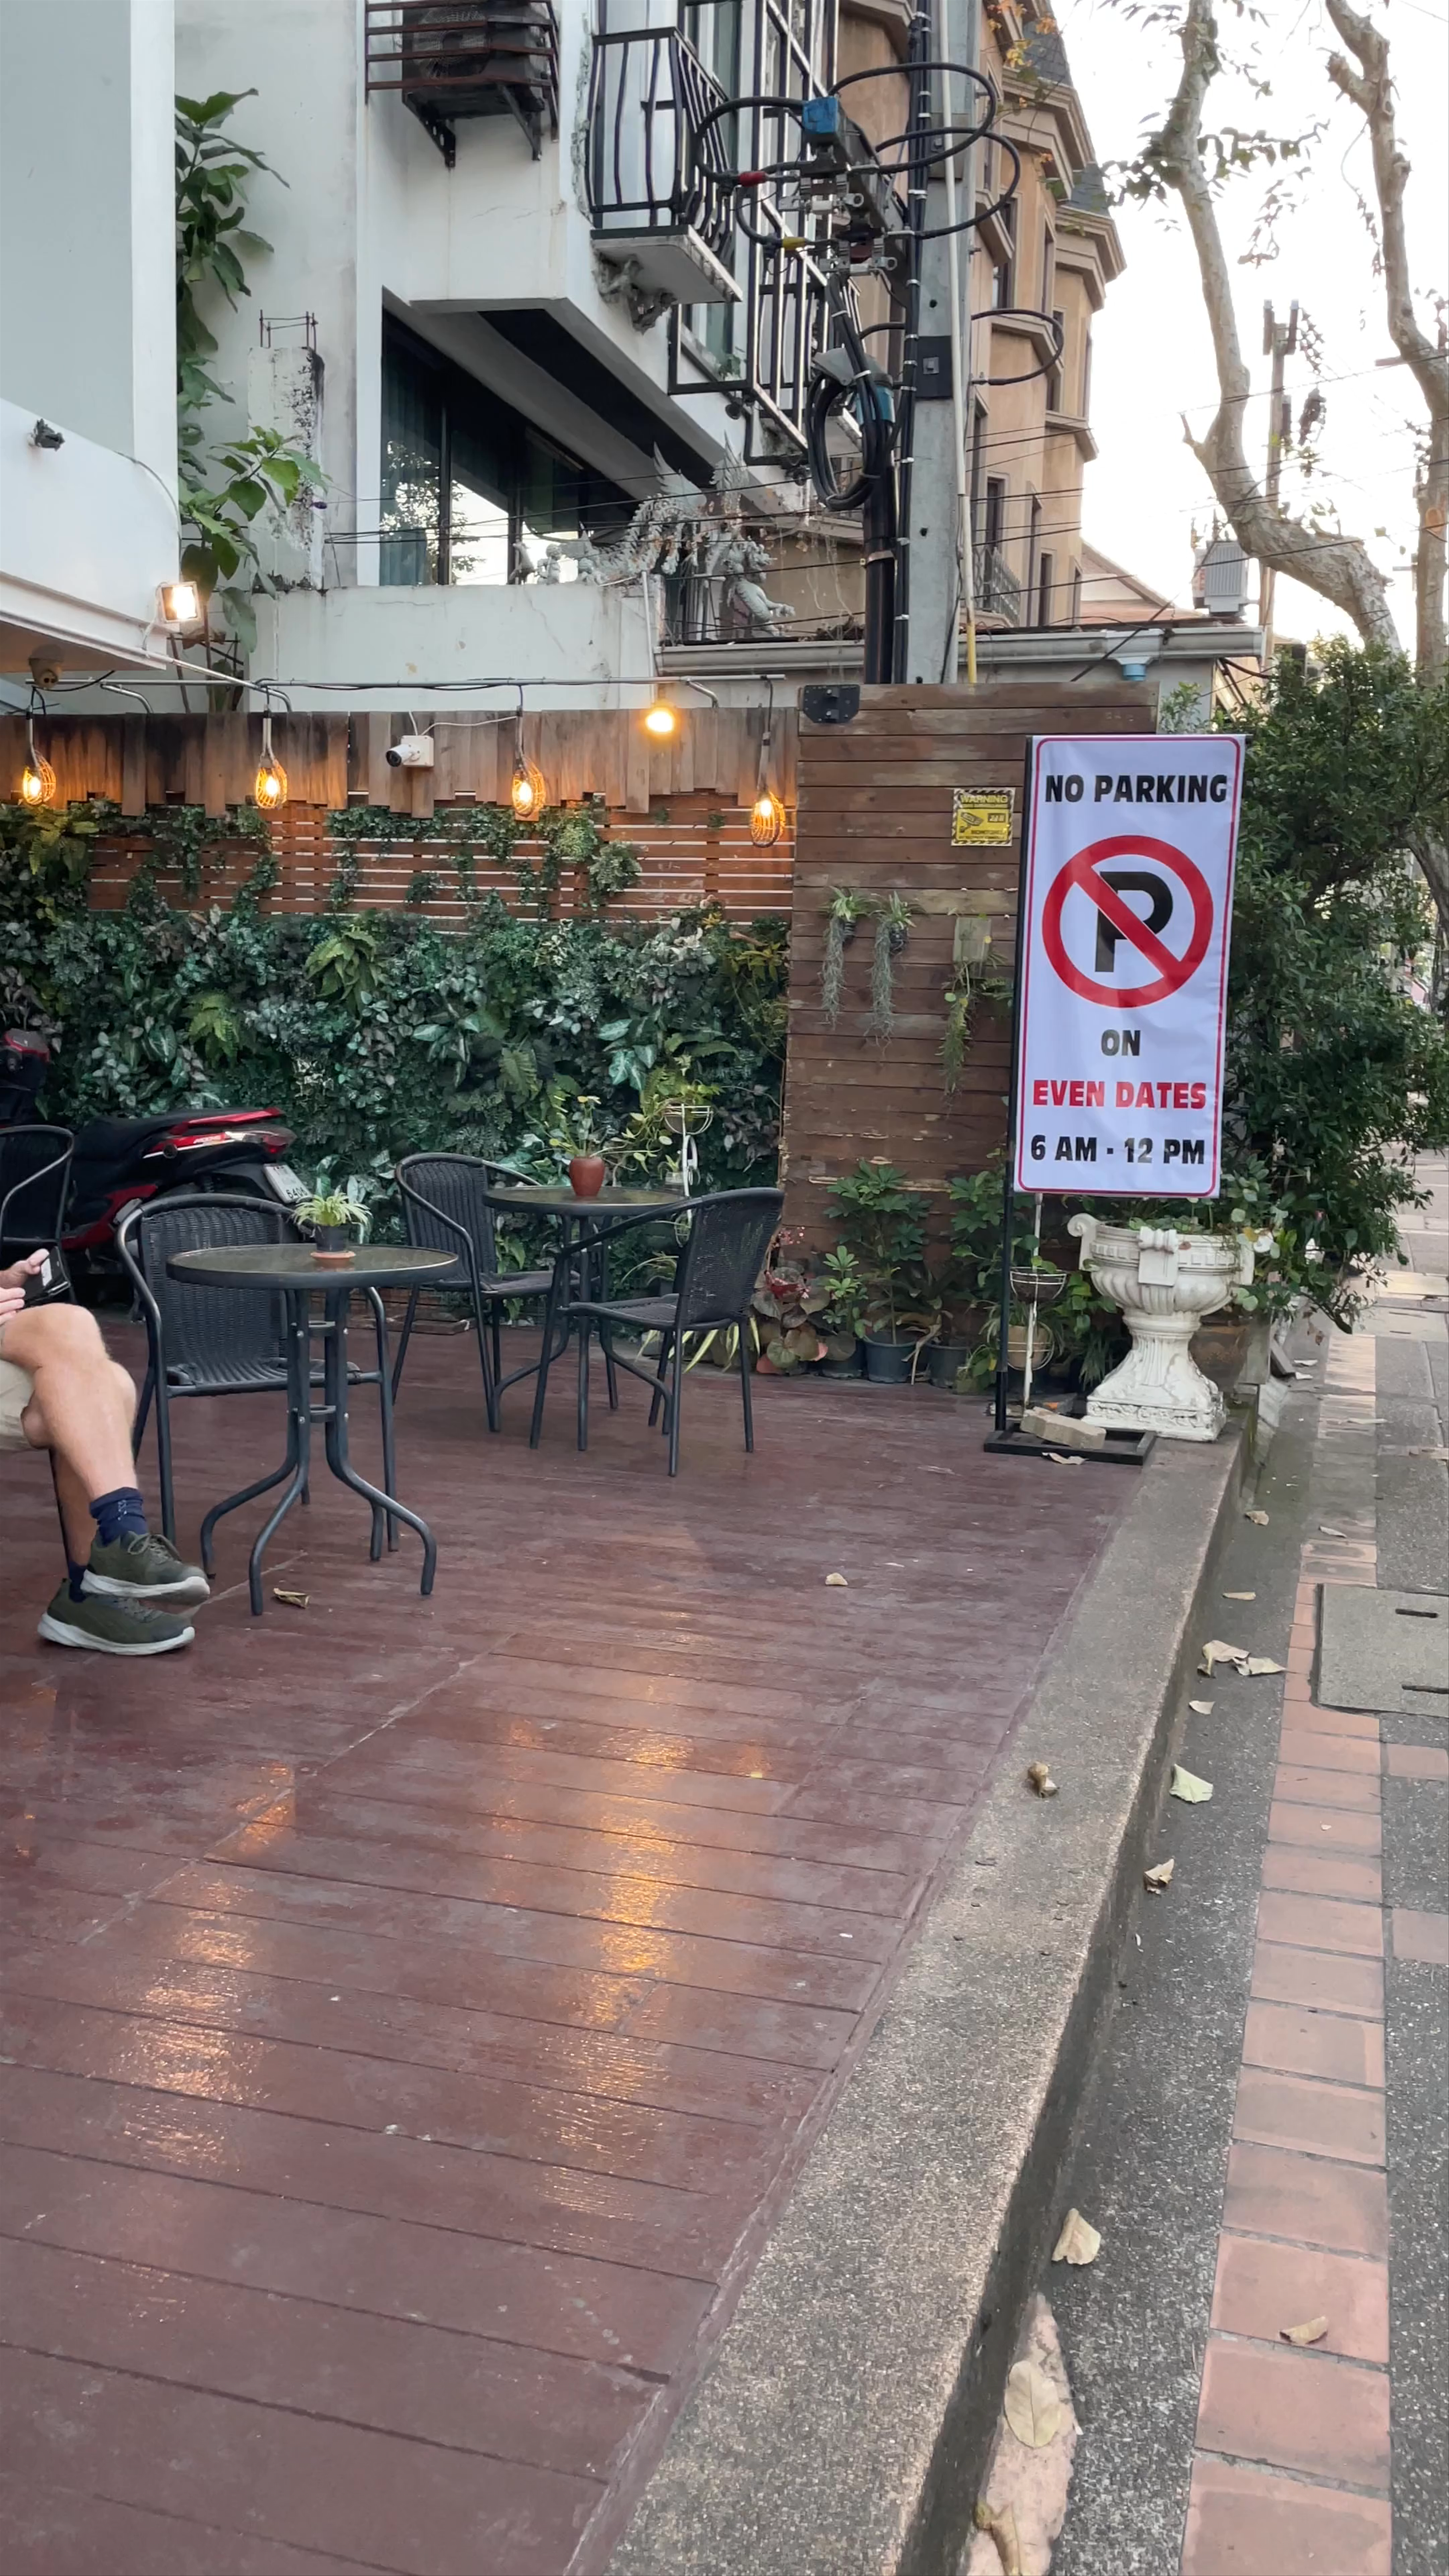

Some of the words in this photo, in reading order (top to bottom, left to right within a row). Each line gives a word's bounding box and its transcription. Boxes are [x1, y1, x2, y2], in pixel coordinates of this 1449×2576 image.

[960, 795, 1008, 803] WARNING
[1045, 774, 1084, 803] NO
[1094, 774, 1228, 803] PARKING
[1101, 1029, 1141, 1056] ON
[1033, 1080, 1104, 1107] EVEN
[1116, 1081, 1206, 1109] DATES
[1031, 1135, 1046, 1160] 6
[1054, 1136, 1097, 1162] AM
[1124, 1138, 1153, 1163] 12
[1163, 1139, 1205, 1164] PM
